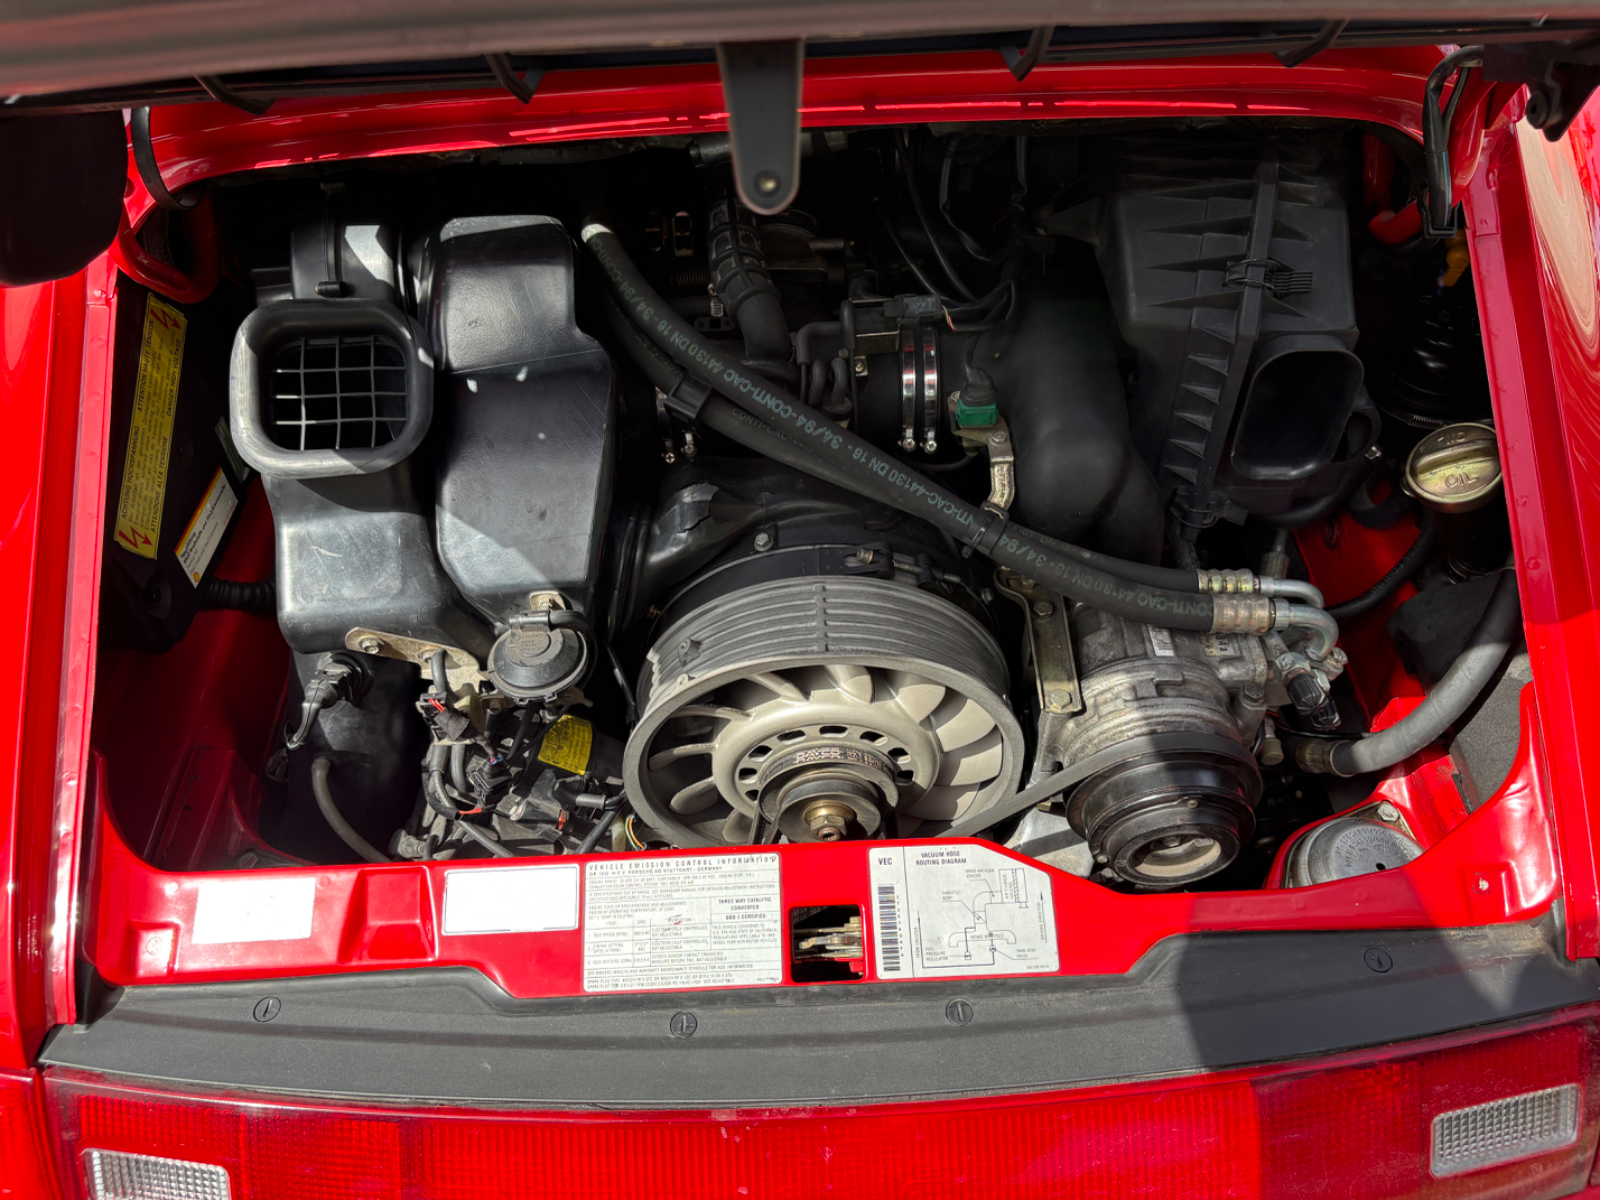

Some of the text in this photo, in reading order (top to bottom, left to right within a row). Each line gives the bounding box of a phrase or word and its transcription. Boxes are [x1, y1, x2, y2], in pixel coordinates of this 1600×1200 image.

[620, 281, 654, 320] 34/94
[657, 320, 673, 336] 16
[670, 331, 691, 352] DN
[171, 338, 182, 368] VOLTAGE
[688, 344, 724, 373] 44130
[169, 370, 177, 387] HIGH
[165, 388, 175, 416] DANGER
[120, 319, 155, 519] ACHTUNG HOCHSPANNUNG ATTENTION HAUTE TENSION
[158, 435, 169, 468] TENSIONE
[852, 447, 868, 464] 16
[868, 457, 890, 477] DN
[155, 471, 164, 488] ALTA
[1445, 472, 1479, 488] OIL
[149, 490, 162, 532] ATTENZIONE
[998, 534, 1047, 567] 34/94
[1072, 571, 1092, 589] DN
[878, 857, 893, 866] VEC
[941, 857, 967, 865] DIAGRAM
